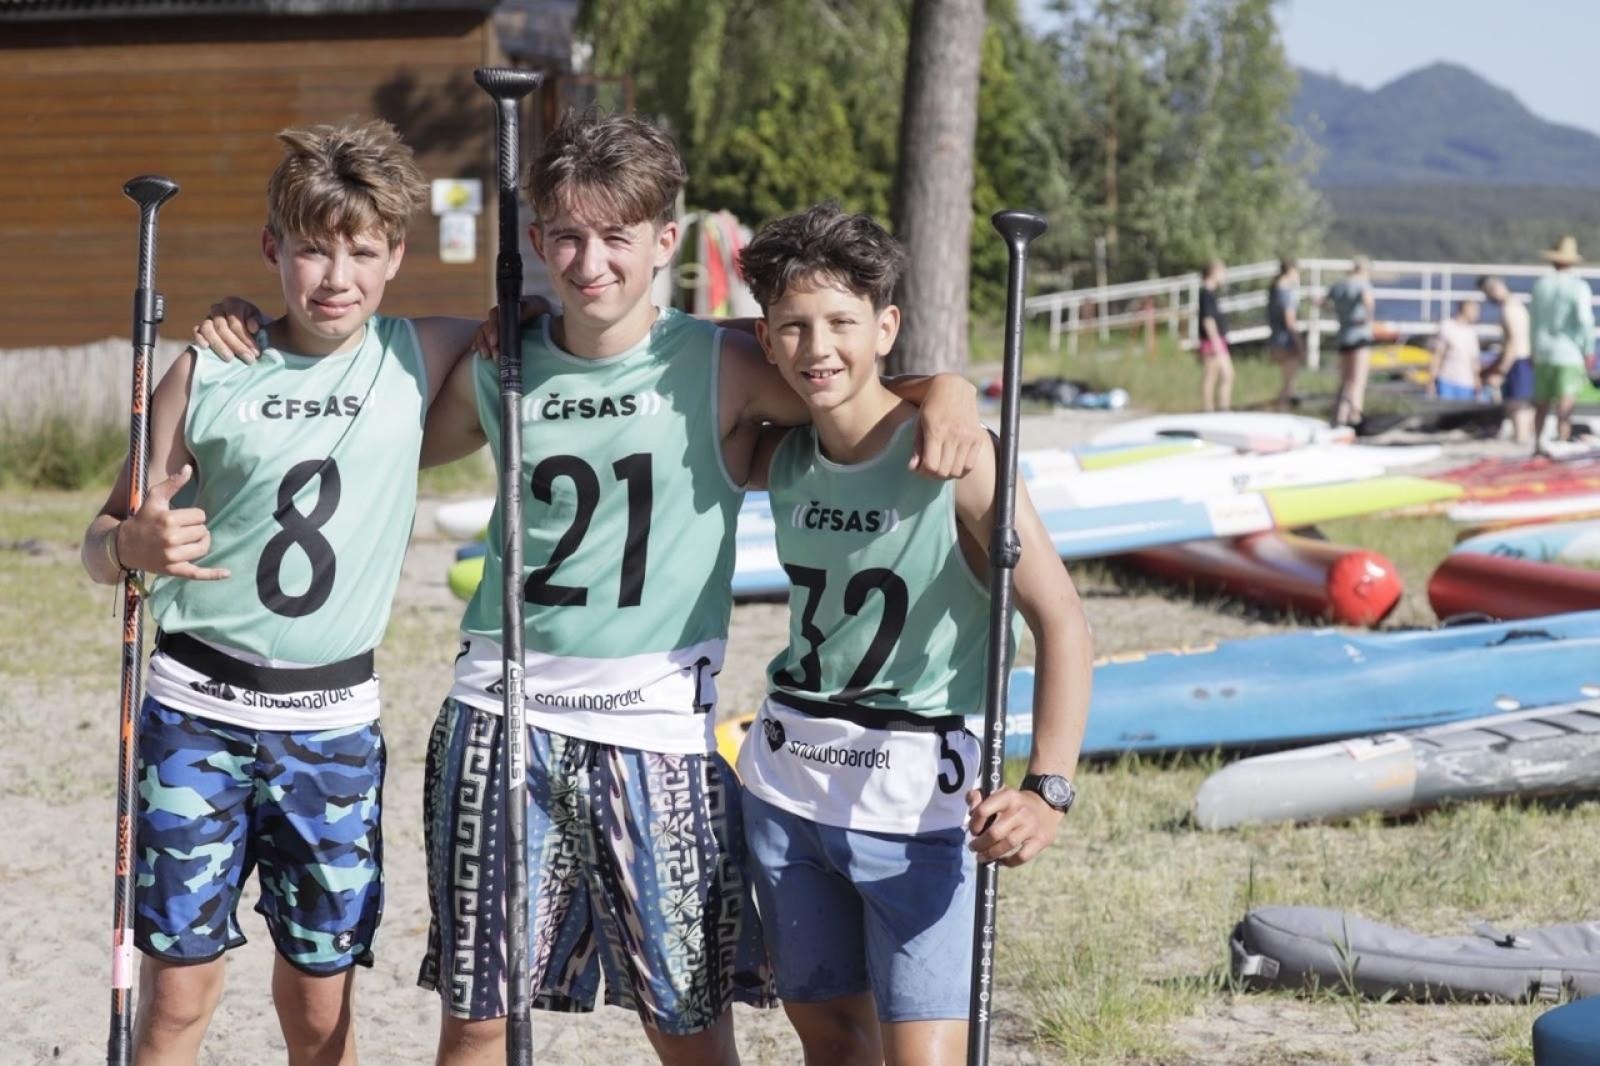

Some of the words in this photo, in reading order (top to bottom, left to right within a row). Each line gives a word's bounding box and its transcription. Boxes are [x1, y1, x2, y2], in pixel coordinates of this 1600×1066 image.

[261, 394, 361, 420] ČFSAS
[542, 393, 638, 420] ČFSAS
[524, 452, 654, 609] 21
[804, 501, 881, 533] ČFSAS
[256, 456, 342, 619] 8
[772, 563, 910, 703] 32
[788, 740, 891, 770] snowboardel
[984, 888, 994, 908] IS
[979, 925, 993, 1022] WONDER
